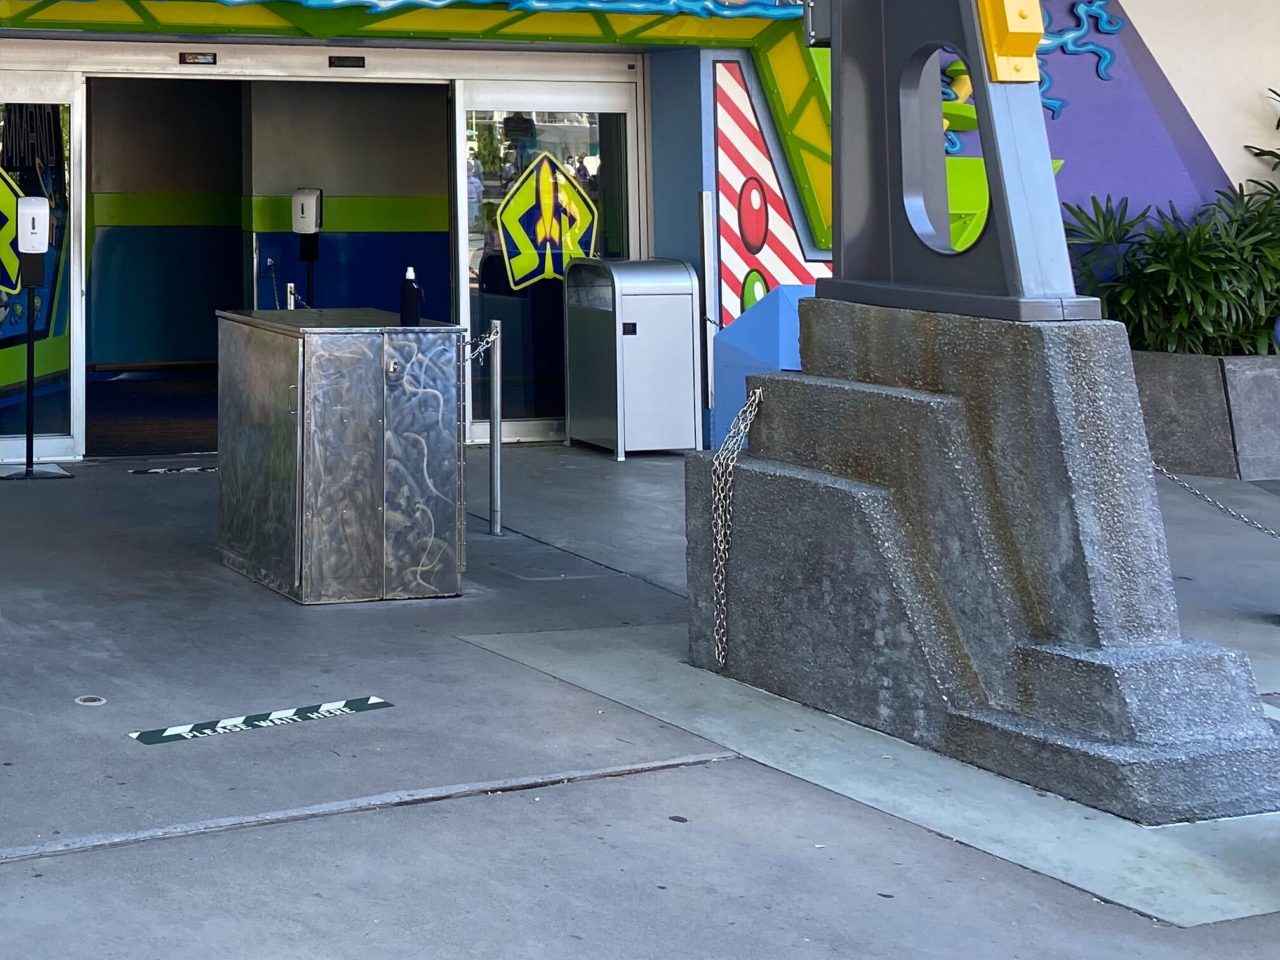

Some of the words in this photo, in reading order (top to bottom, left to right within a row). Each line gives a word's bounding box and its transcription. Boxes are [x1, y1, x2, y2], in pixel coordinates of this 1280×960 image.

[182, 722, 253, 740] PLEASE
[253, 714, 301, 728] WAIT
[306, 706, 356, 719] HERE
